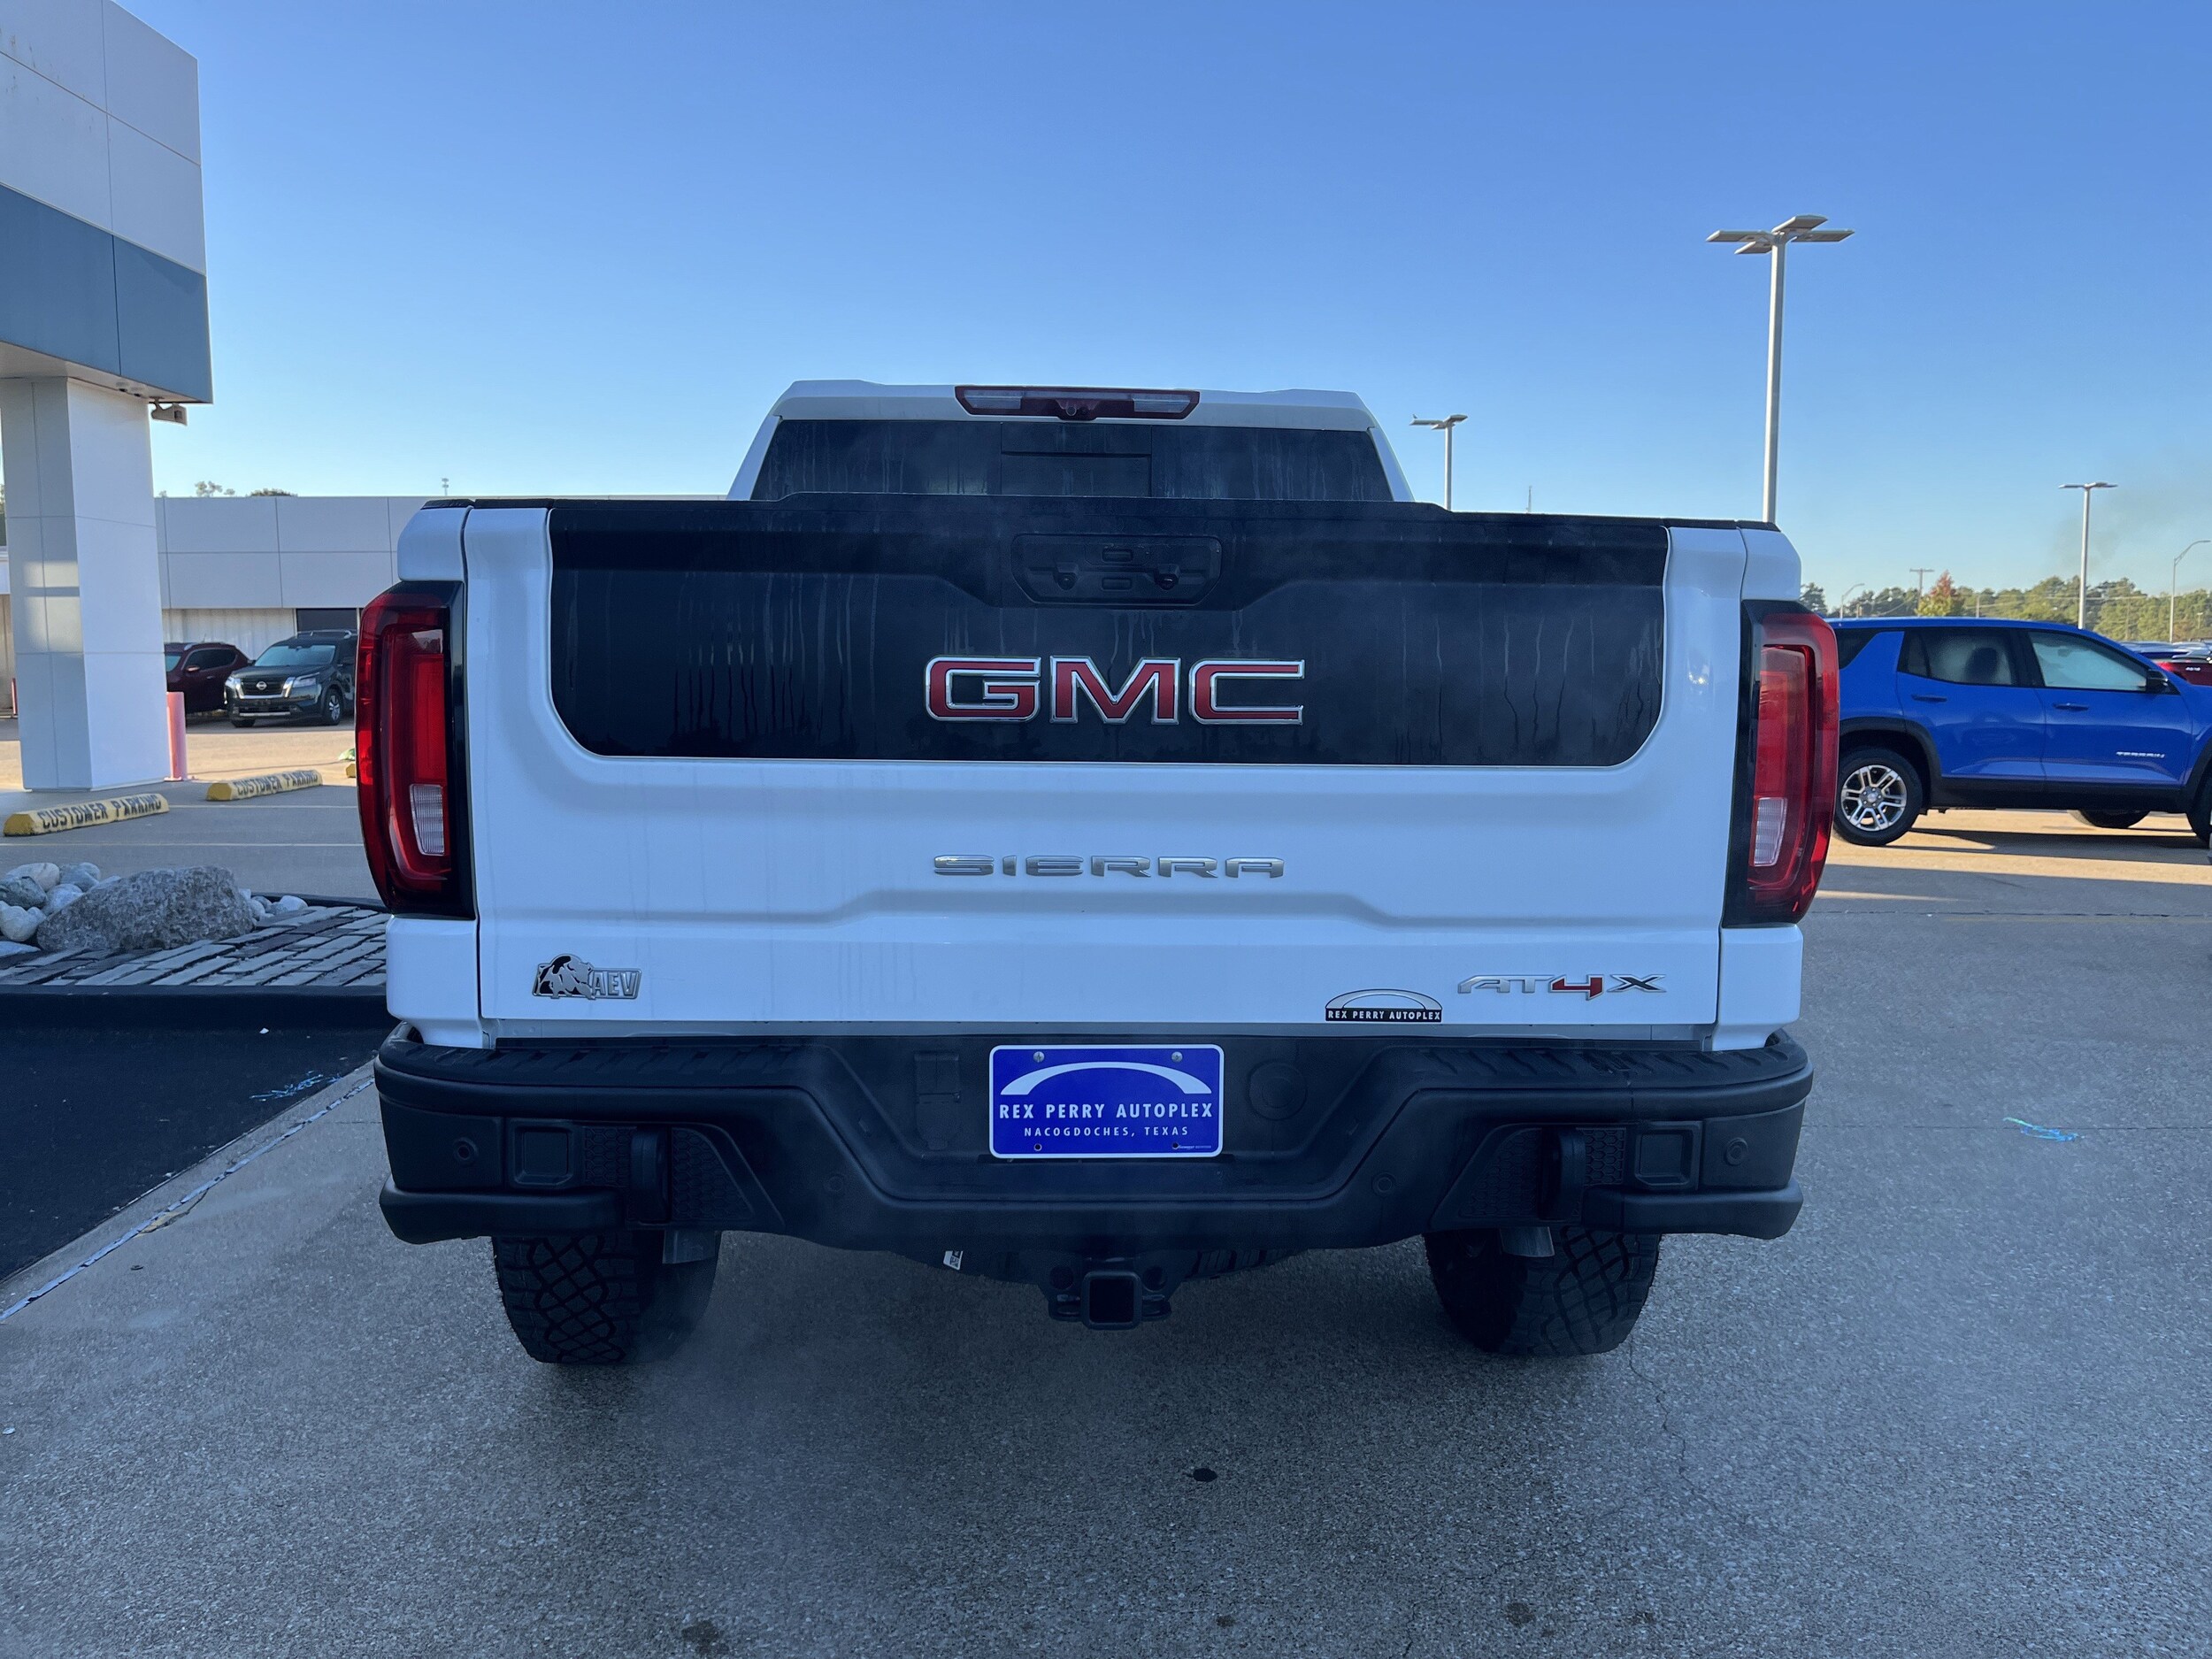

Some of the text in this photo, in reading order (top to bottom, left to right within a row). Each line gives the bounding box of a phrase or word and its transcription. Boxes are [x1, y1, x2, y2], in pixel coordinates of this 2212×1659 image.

[925, 655, 1305, 726] GMC
[236, 769, 319, 797] CUSTOMER PARKING
[38, 793, 163, 830] CUSTOMER PARKING
[933, 854, 1285, 879] SIERRA
[591, 970, 638, 996] AEV
[1457, 973, 1667, 1002] AT4X
[1328, 1010, 1440, 1021] REX PERRY AUTOPLEX
[999, 1102, 1213, 1119] REX PERRY AUTOPLEX
[1024, 1125, 1189, 1138] NACOGDOCHES, TEXAS
